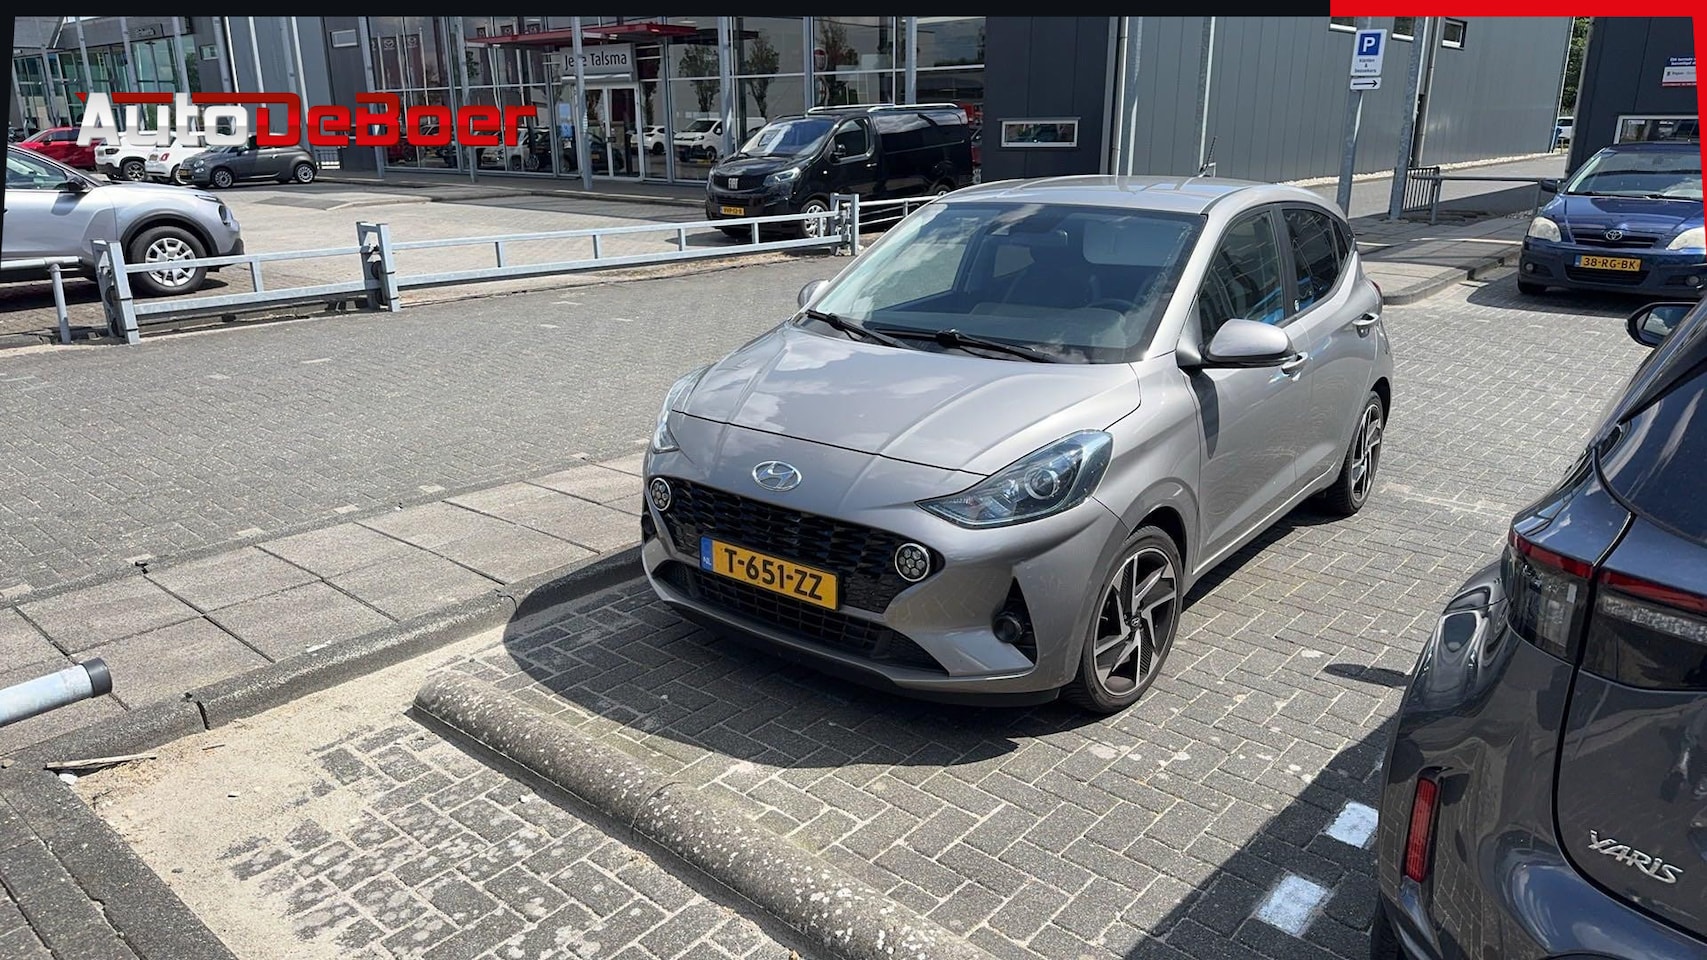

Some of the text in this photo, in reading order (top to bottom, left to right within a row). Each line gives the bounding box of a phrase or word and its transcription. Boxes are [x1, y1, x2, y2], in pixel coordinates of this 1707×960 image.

[1362, 36, 1376, 53] P
[565, 51, 627, 71] Jee Talsma
[1583, 257, 1637, 270] 38-RG-BK
[724, 548, 823, 601] T-651-ZZ
[1587, 829, 1684, 884] YARIS
